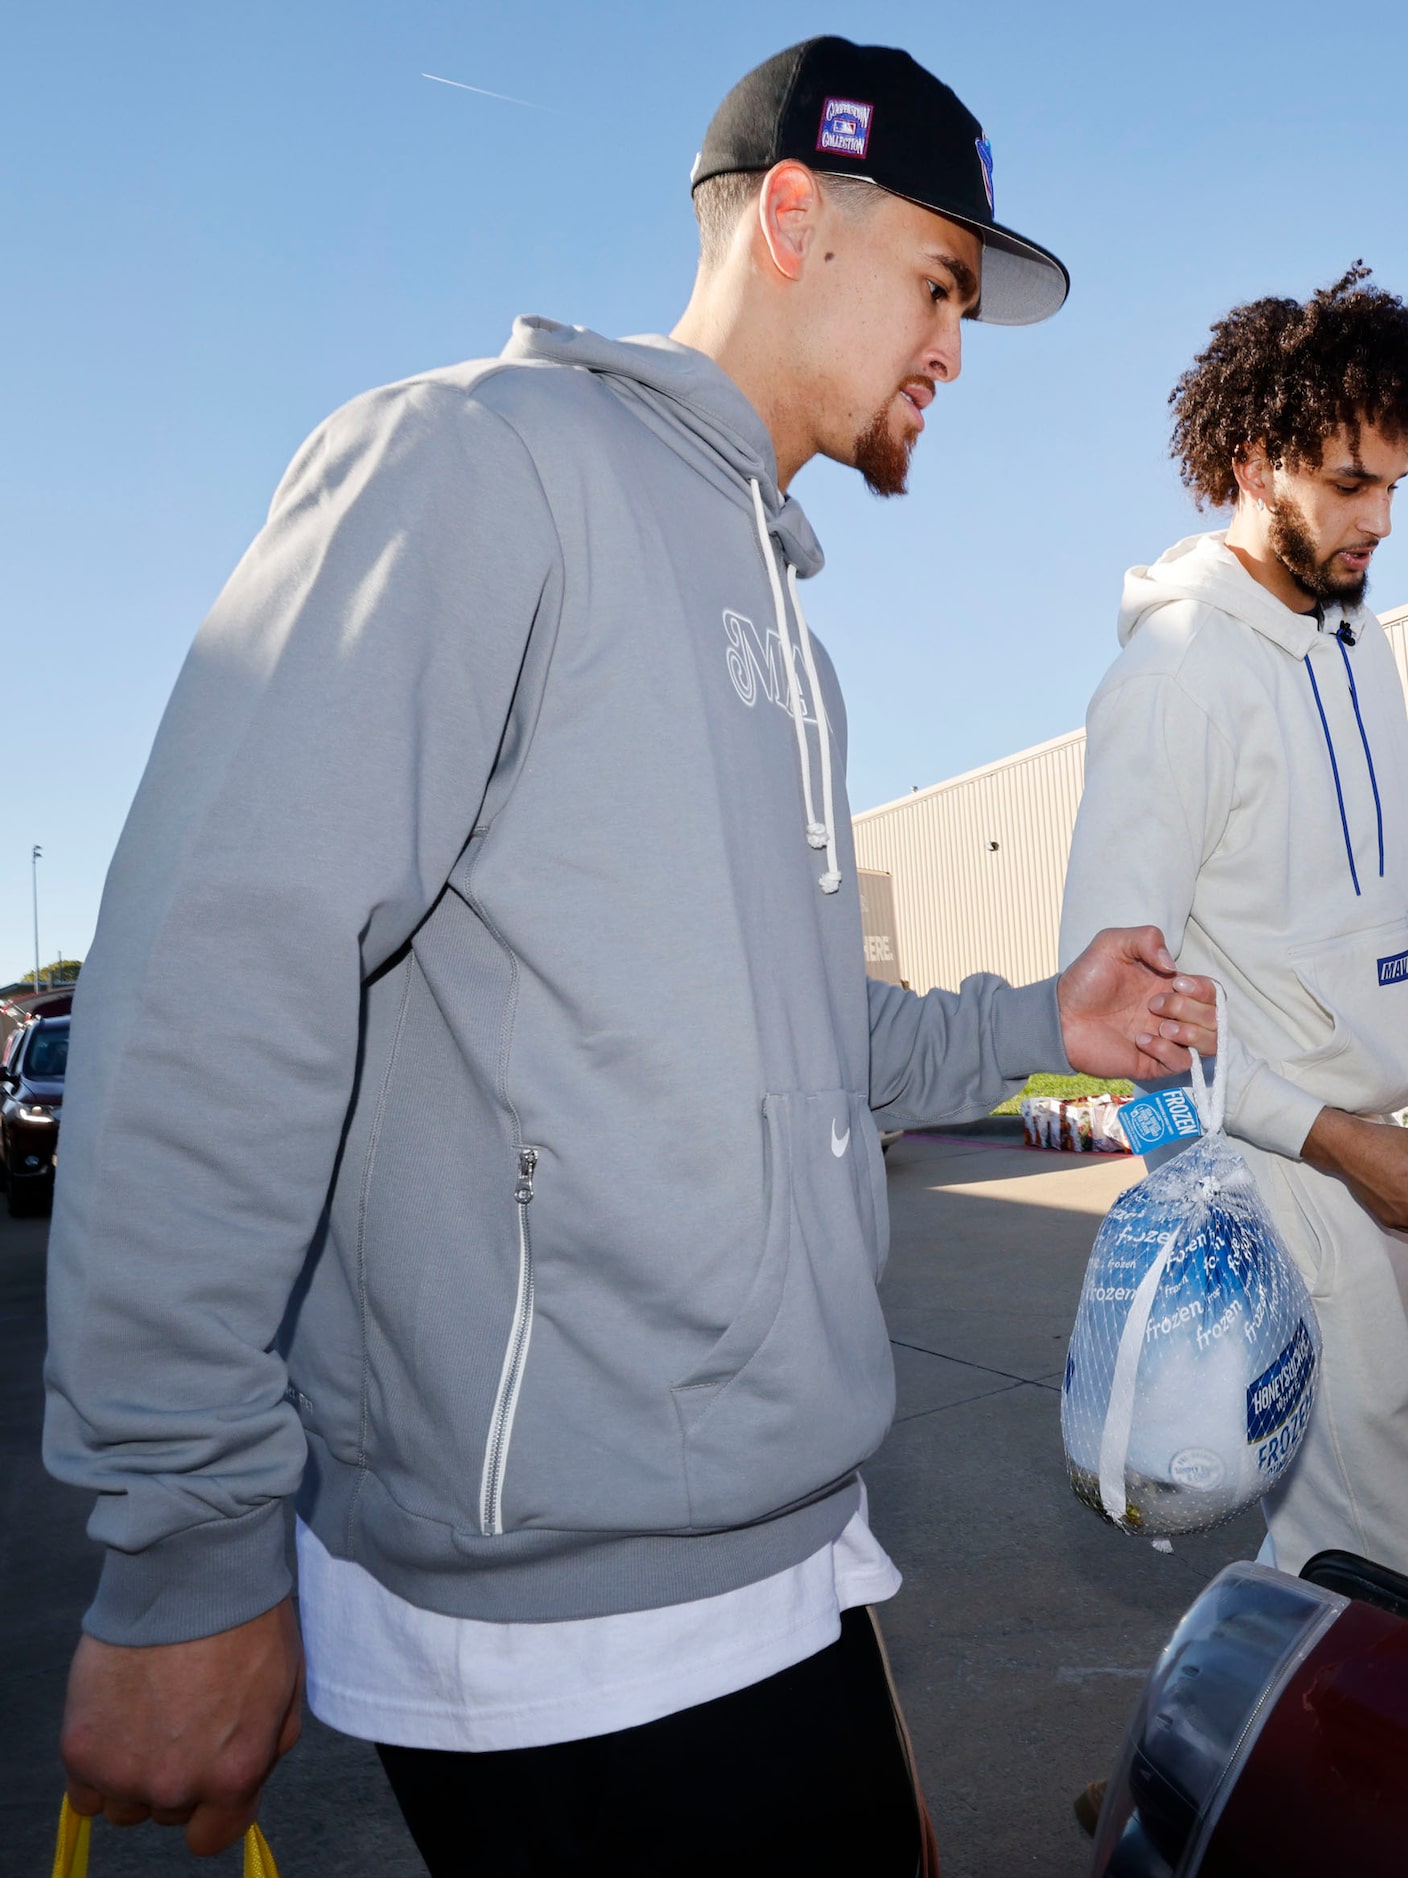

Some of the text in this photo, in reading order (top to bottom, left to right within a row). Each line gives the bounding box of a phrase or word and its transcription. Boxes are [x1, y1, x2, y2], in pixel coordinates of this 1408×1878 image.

[822, 130, 865, 154] COLLECTION
[1162, 1089, 1200, 1136] FROZEN
[1108, 1259, 1137, 1269] frozen
[1145, 1299, 1205, 1343] frozen
[1196, 1299, 1243, 1351] frozen
[1275, 1375, 1303, 1413] WHITE
[1257, 1384, 1314, 1471] FROZEN
